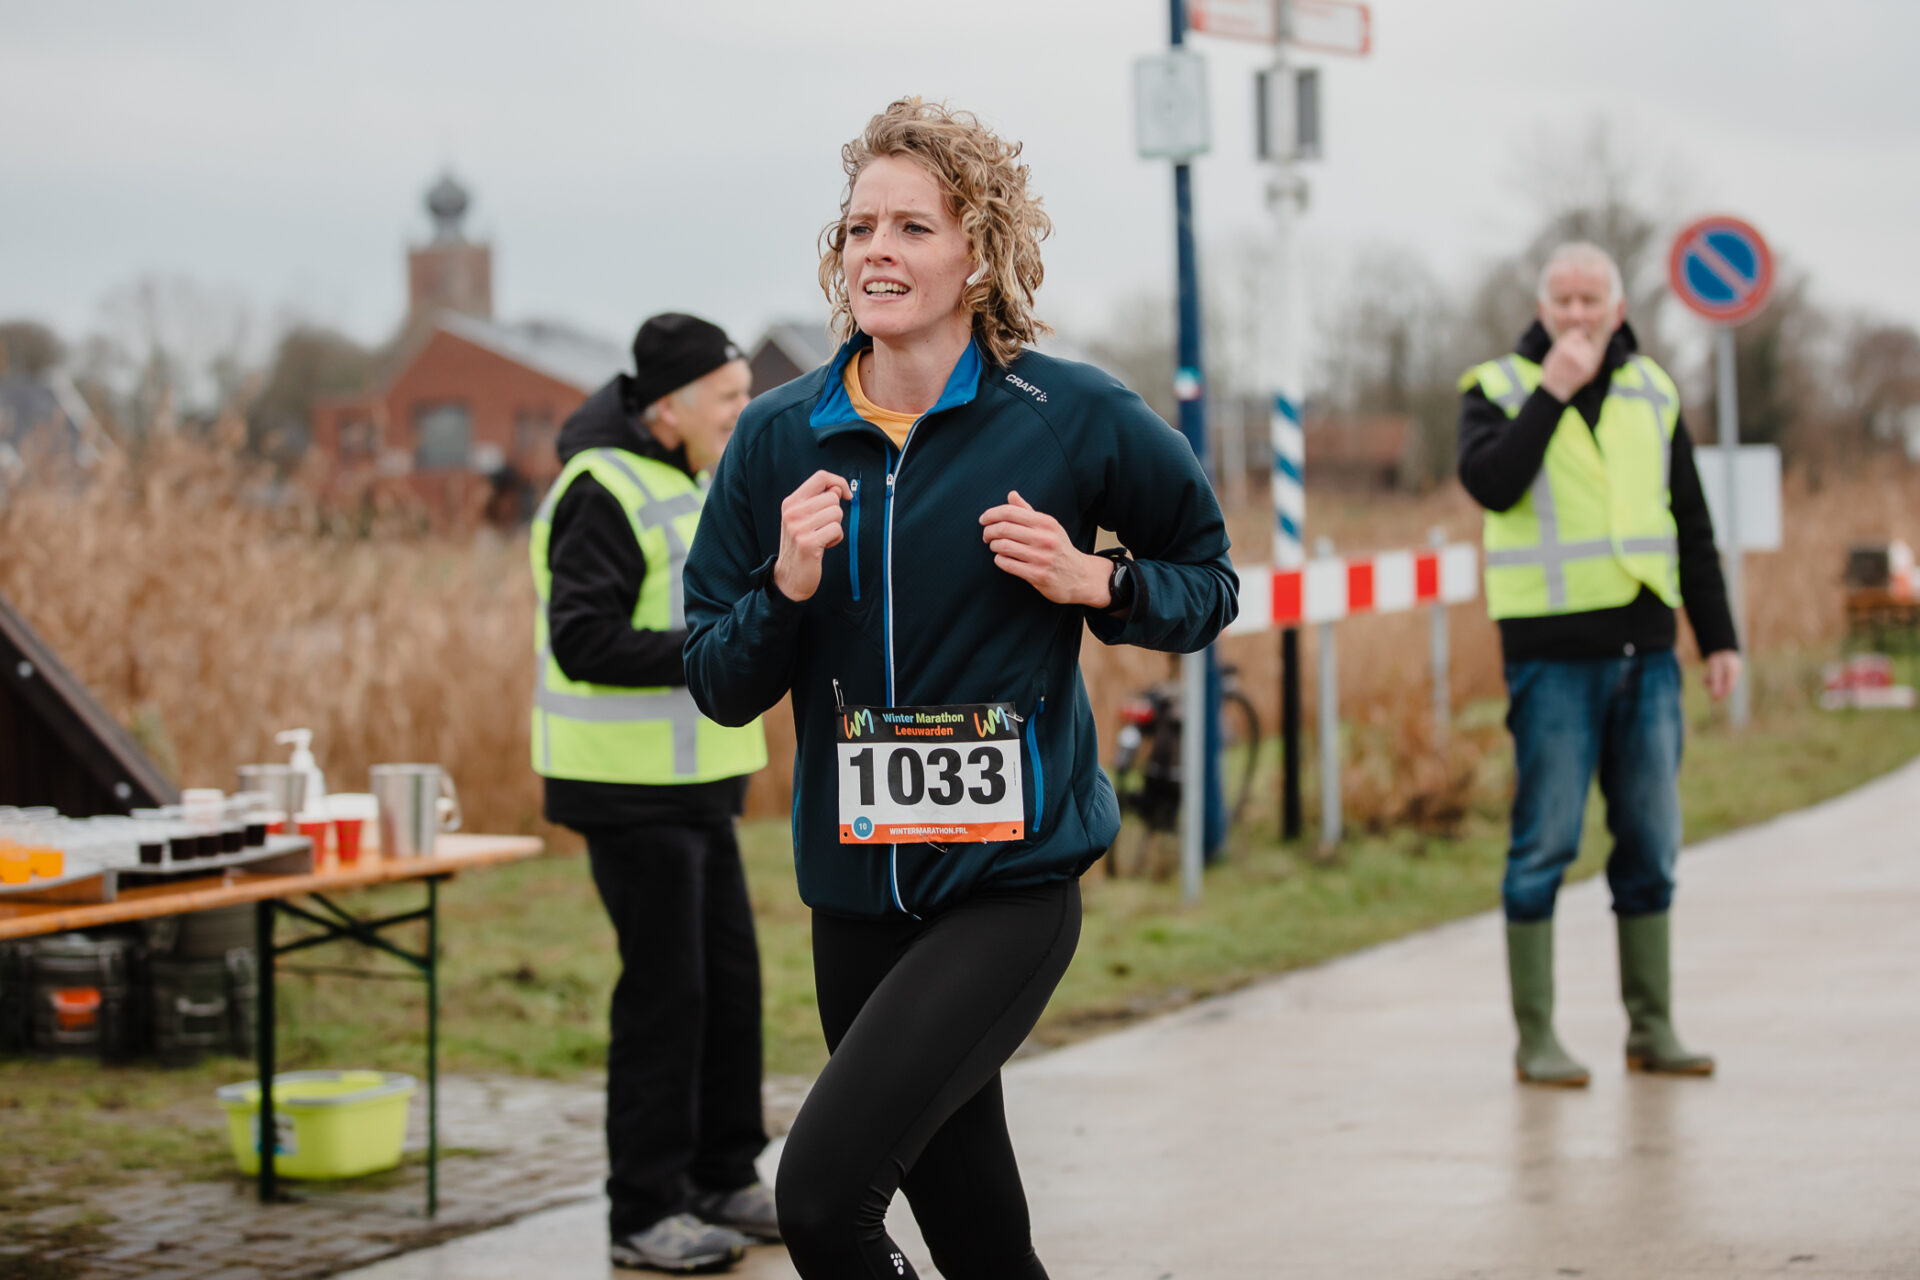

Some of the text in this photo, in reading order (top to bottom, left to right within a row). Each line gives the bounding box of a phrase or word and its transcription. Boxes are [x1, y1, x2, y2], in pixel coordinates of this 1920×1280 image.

[1005, 373, 1042, 396] CRAFT
[882, 712, 964, 724] Winter Marathon
[895, 725, 954, 736] Leeuwarden
[850, 746, 1007, 806] 1033
[889, 827, 968, 835] WINTERMARATHON.FRL
